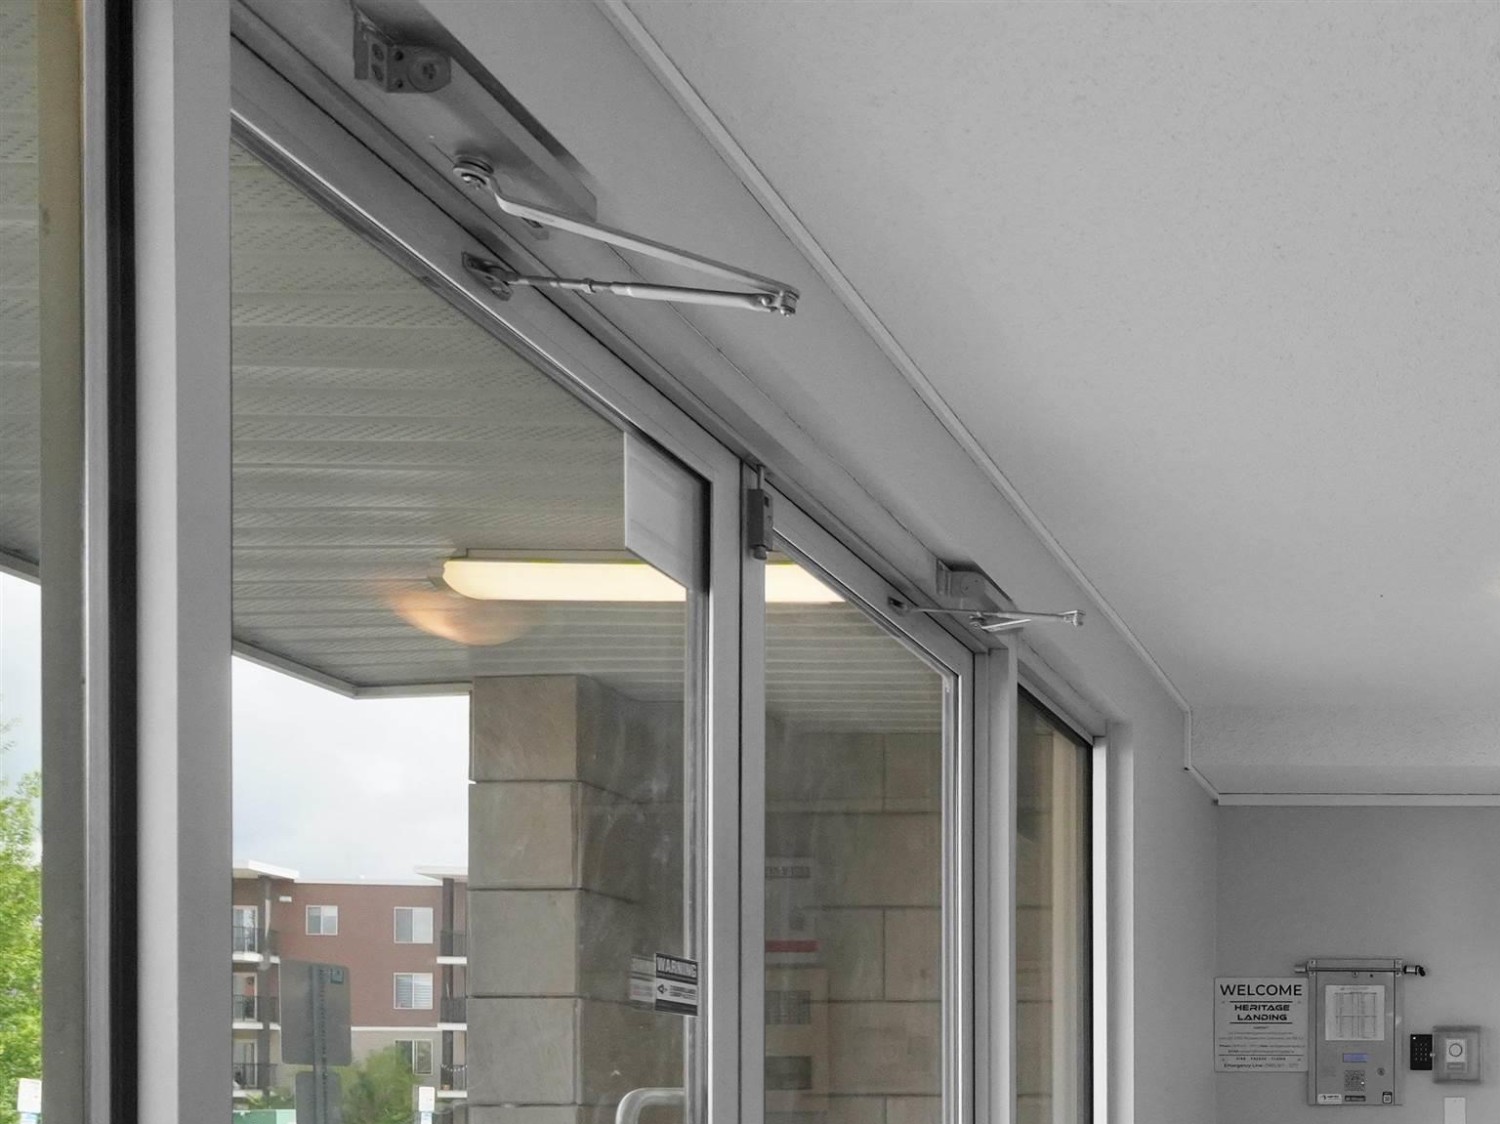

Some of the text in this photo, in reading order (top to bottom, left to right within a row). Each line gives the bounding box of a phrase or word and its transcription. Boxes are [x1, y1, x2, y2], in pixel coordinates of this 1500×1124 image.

[656, 956, 698, 979] WARNING
[1219, 983, 1303, 997] WELCOME
[1234, 1004, 1290, 1012] HERITAGE
[1236, 1013, 1288, 1021] LANDING
